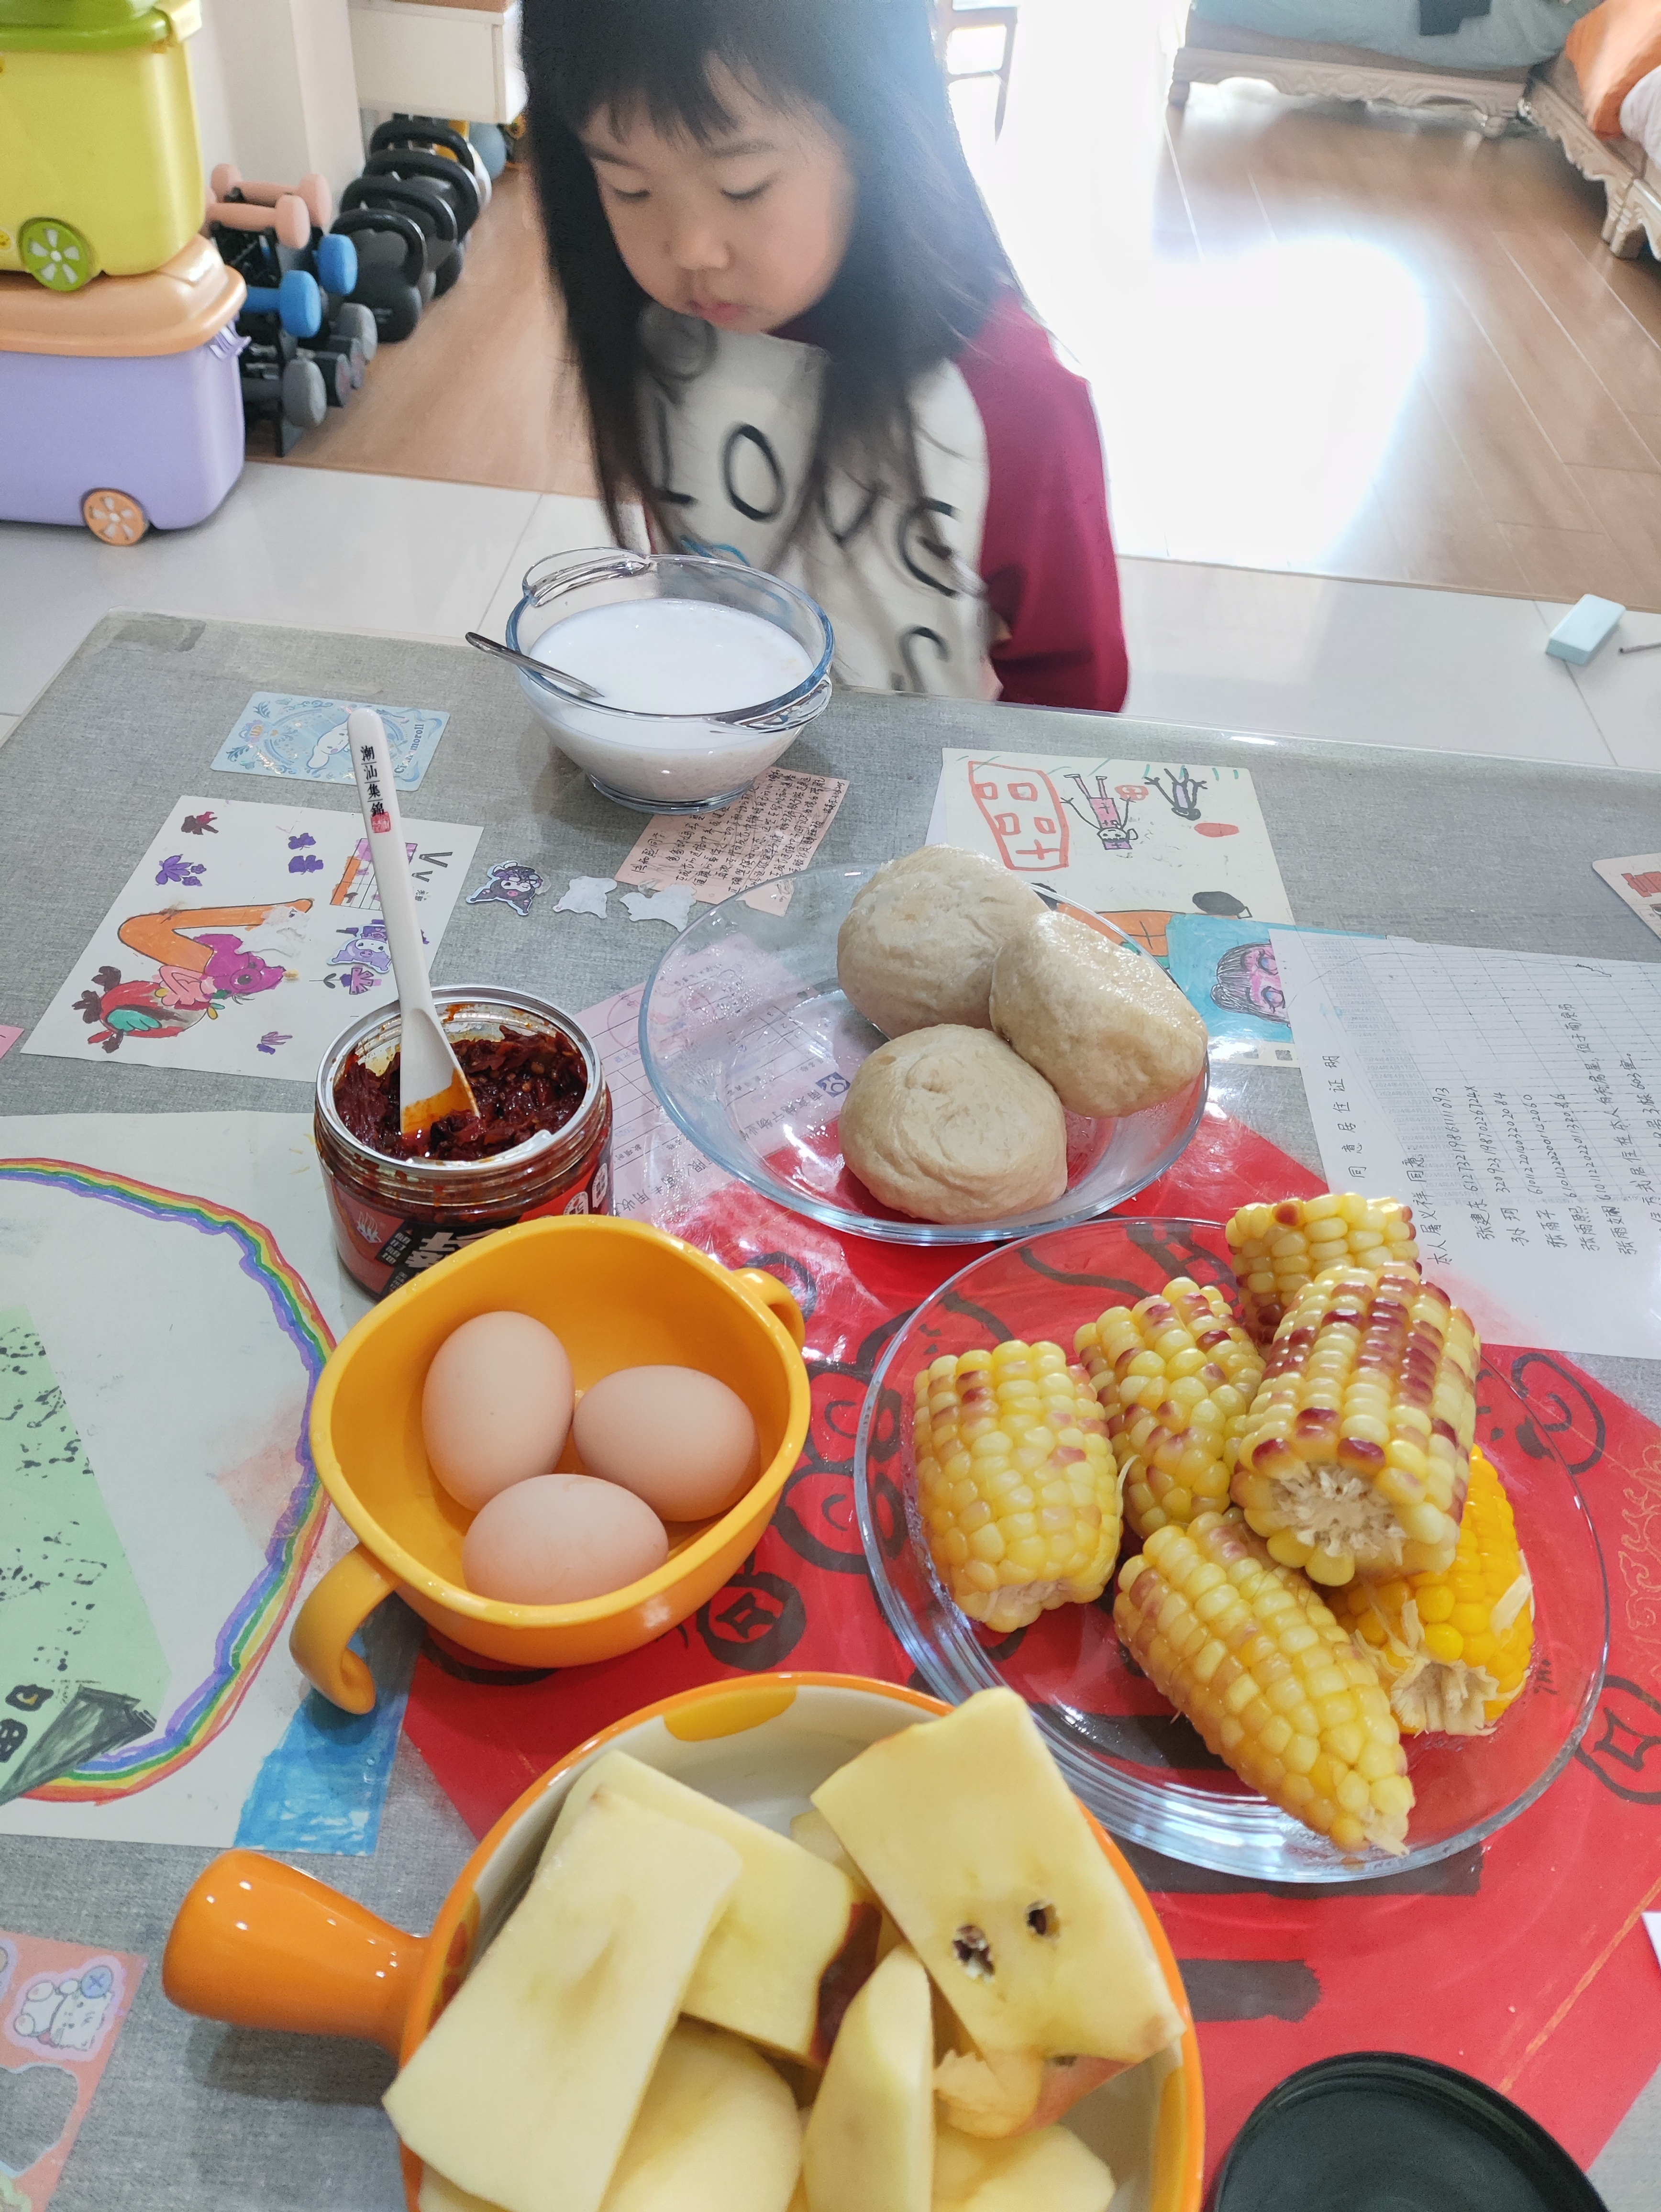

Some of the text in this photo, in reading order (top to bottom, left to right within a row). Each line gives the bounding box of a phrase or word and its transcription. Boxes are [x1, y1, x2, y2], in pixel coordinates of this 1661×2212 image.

[1322, 1055, 1366, 1179] 同意居住证明
